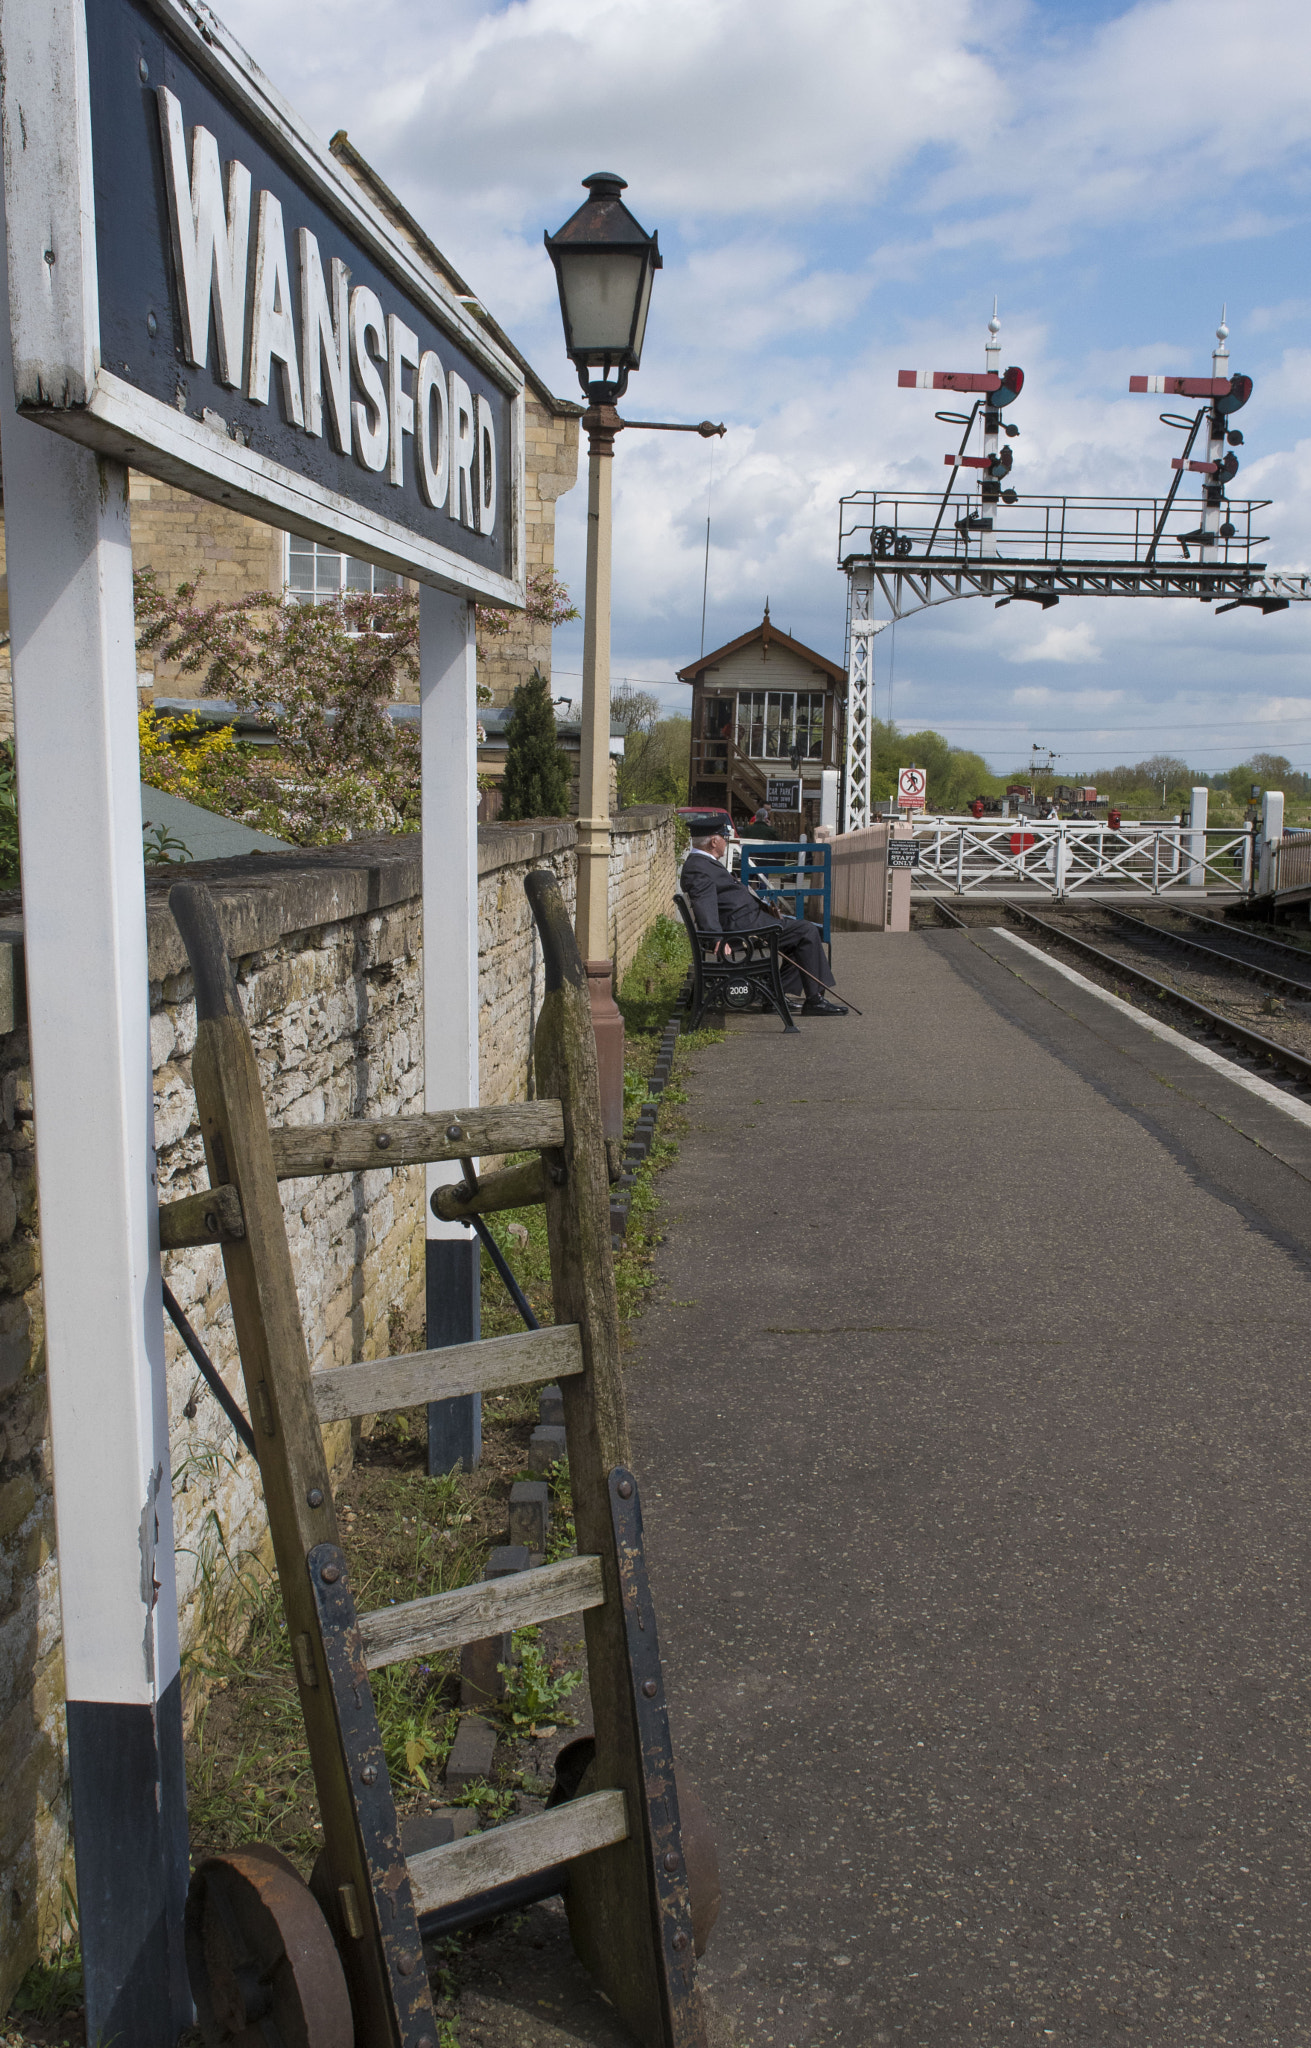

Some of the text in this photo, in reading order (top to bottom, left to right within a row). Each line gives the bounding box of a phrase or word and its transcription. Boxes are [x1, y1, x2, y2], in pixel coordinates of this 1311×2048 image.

[157, 85, 497, 536] WANSFORD
[769, 787, 791, 795] CAR PARK
[730, 986, 749, 994] 2008
